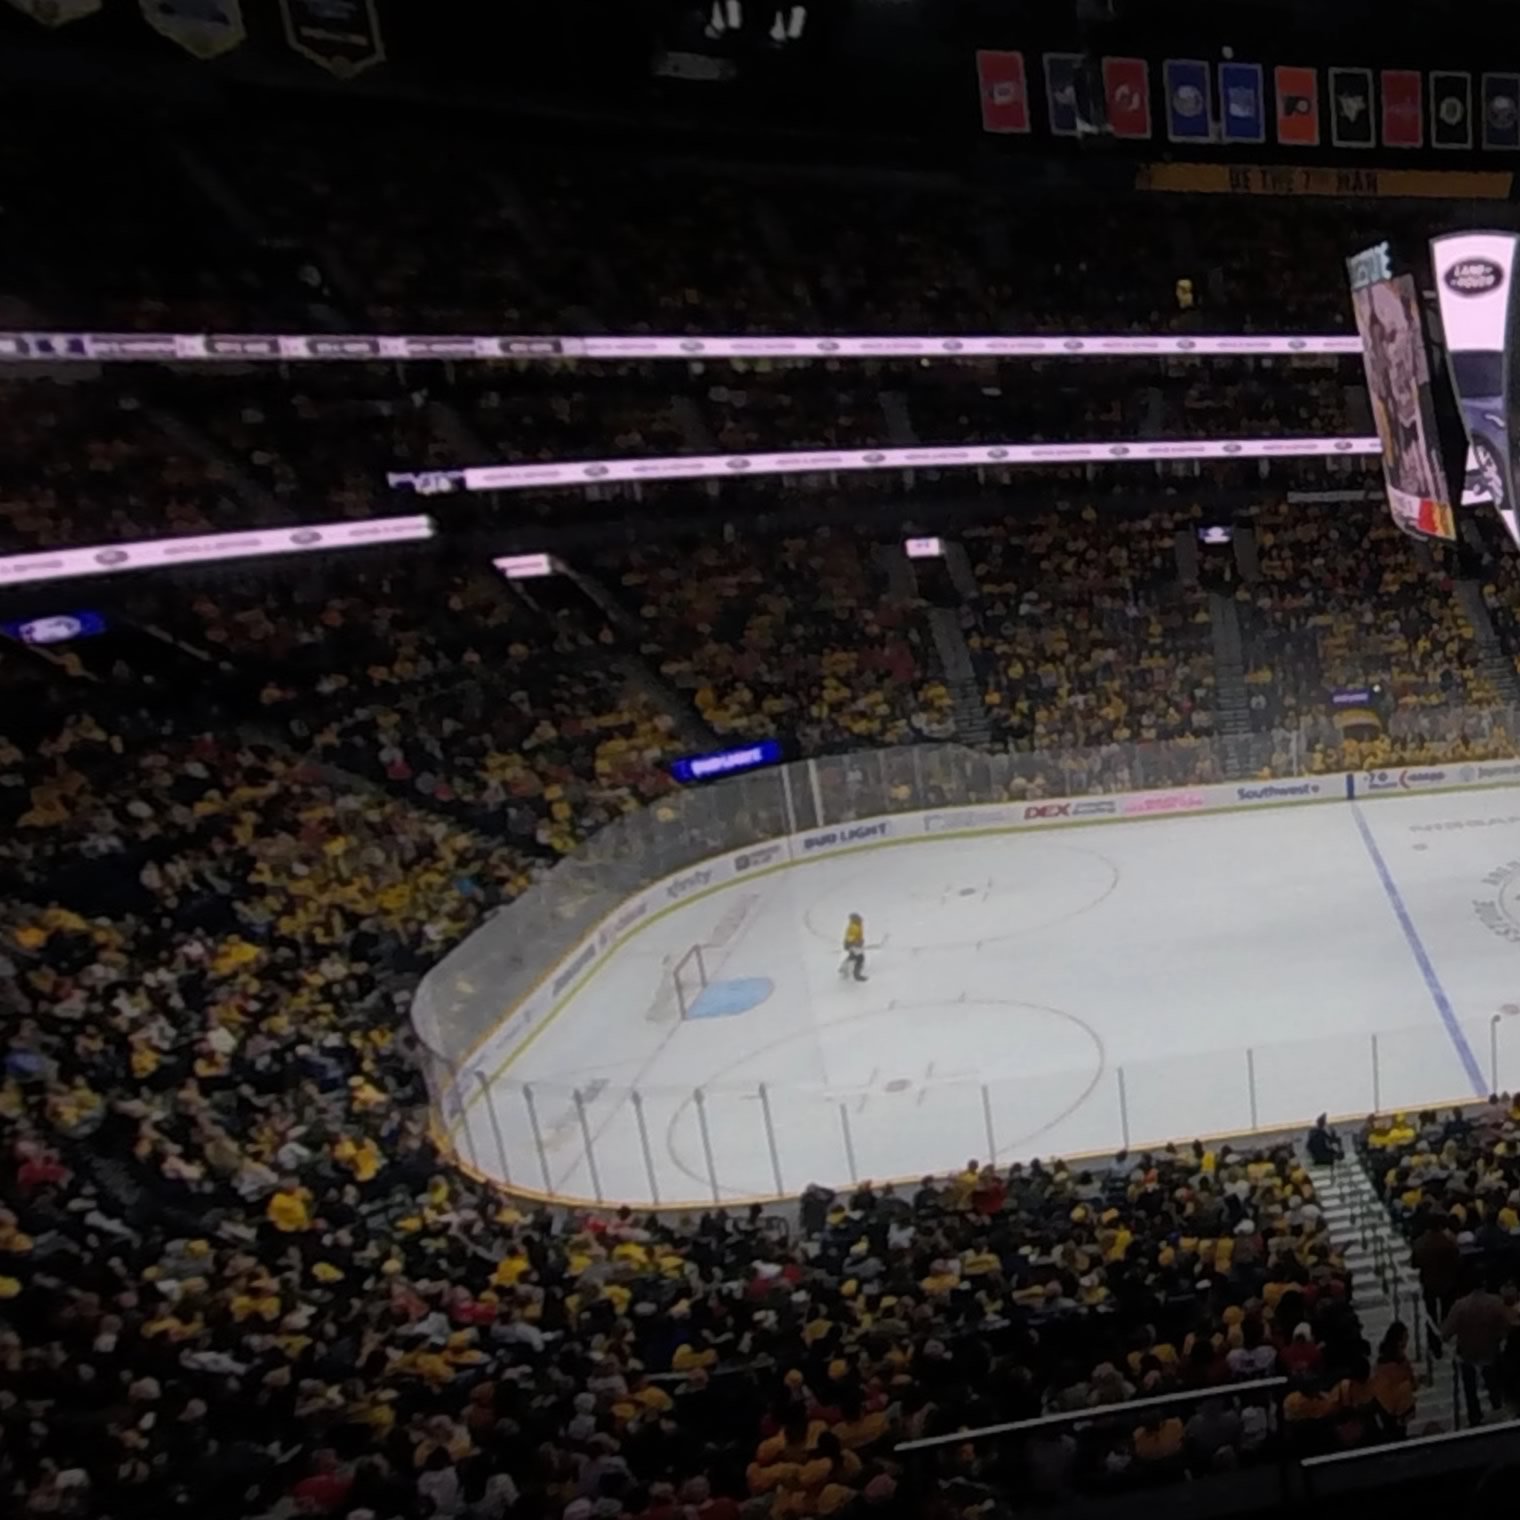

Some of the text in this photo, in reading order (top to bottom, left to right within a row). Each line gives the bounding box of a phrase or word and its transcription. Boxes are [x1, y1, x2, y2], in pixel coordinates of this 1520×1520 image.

[1236, 784, 1310, 801] Southwest
[803, 821, 887, 850] BUD LIGHT
